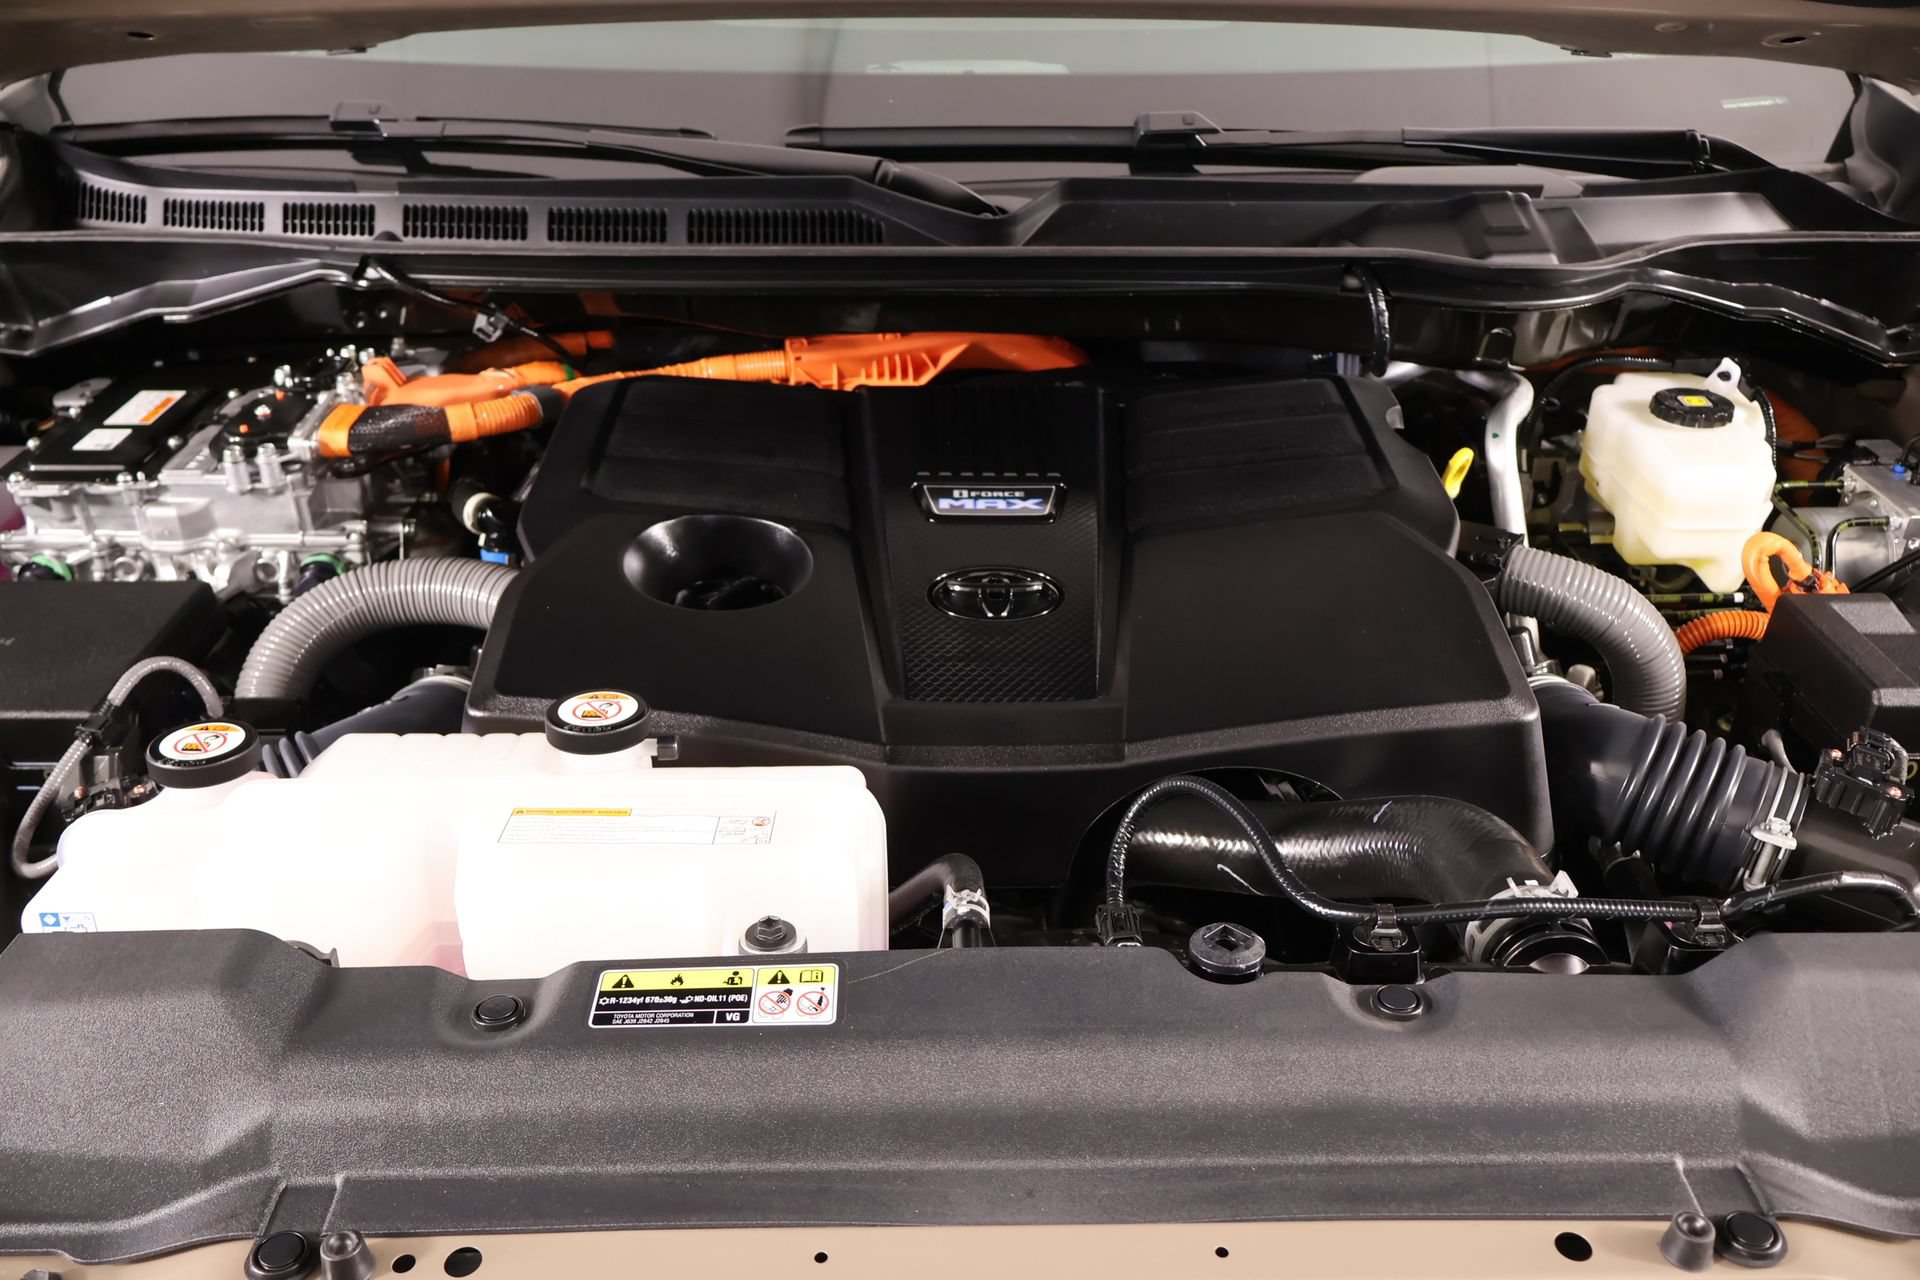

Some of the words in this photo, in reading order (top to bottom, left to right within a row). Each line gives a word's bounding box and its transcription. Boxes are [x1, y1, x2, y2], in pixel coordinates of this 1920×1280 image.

[938, 498, 1044, 509] MAX
[609, 996, 644, 1005] R-1234yf
[728, 993, 748, 1003] (POE)
[725, 1012, 741, 1021] VG
